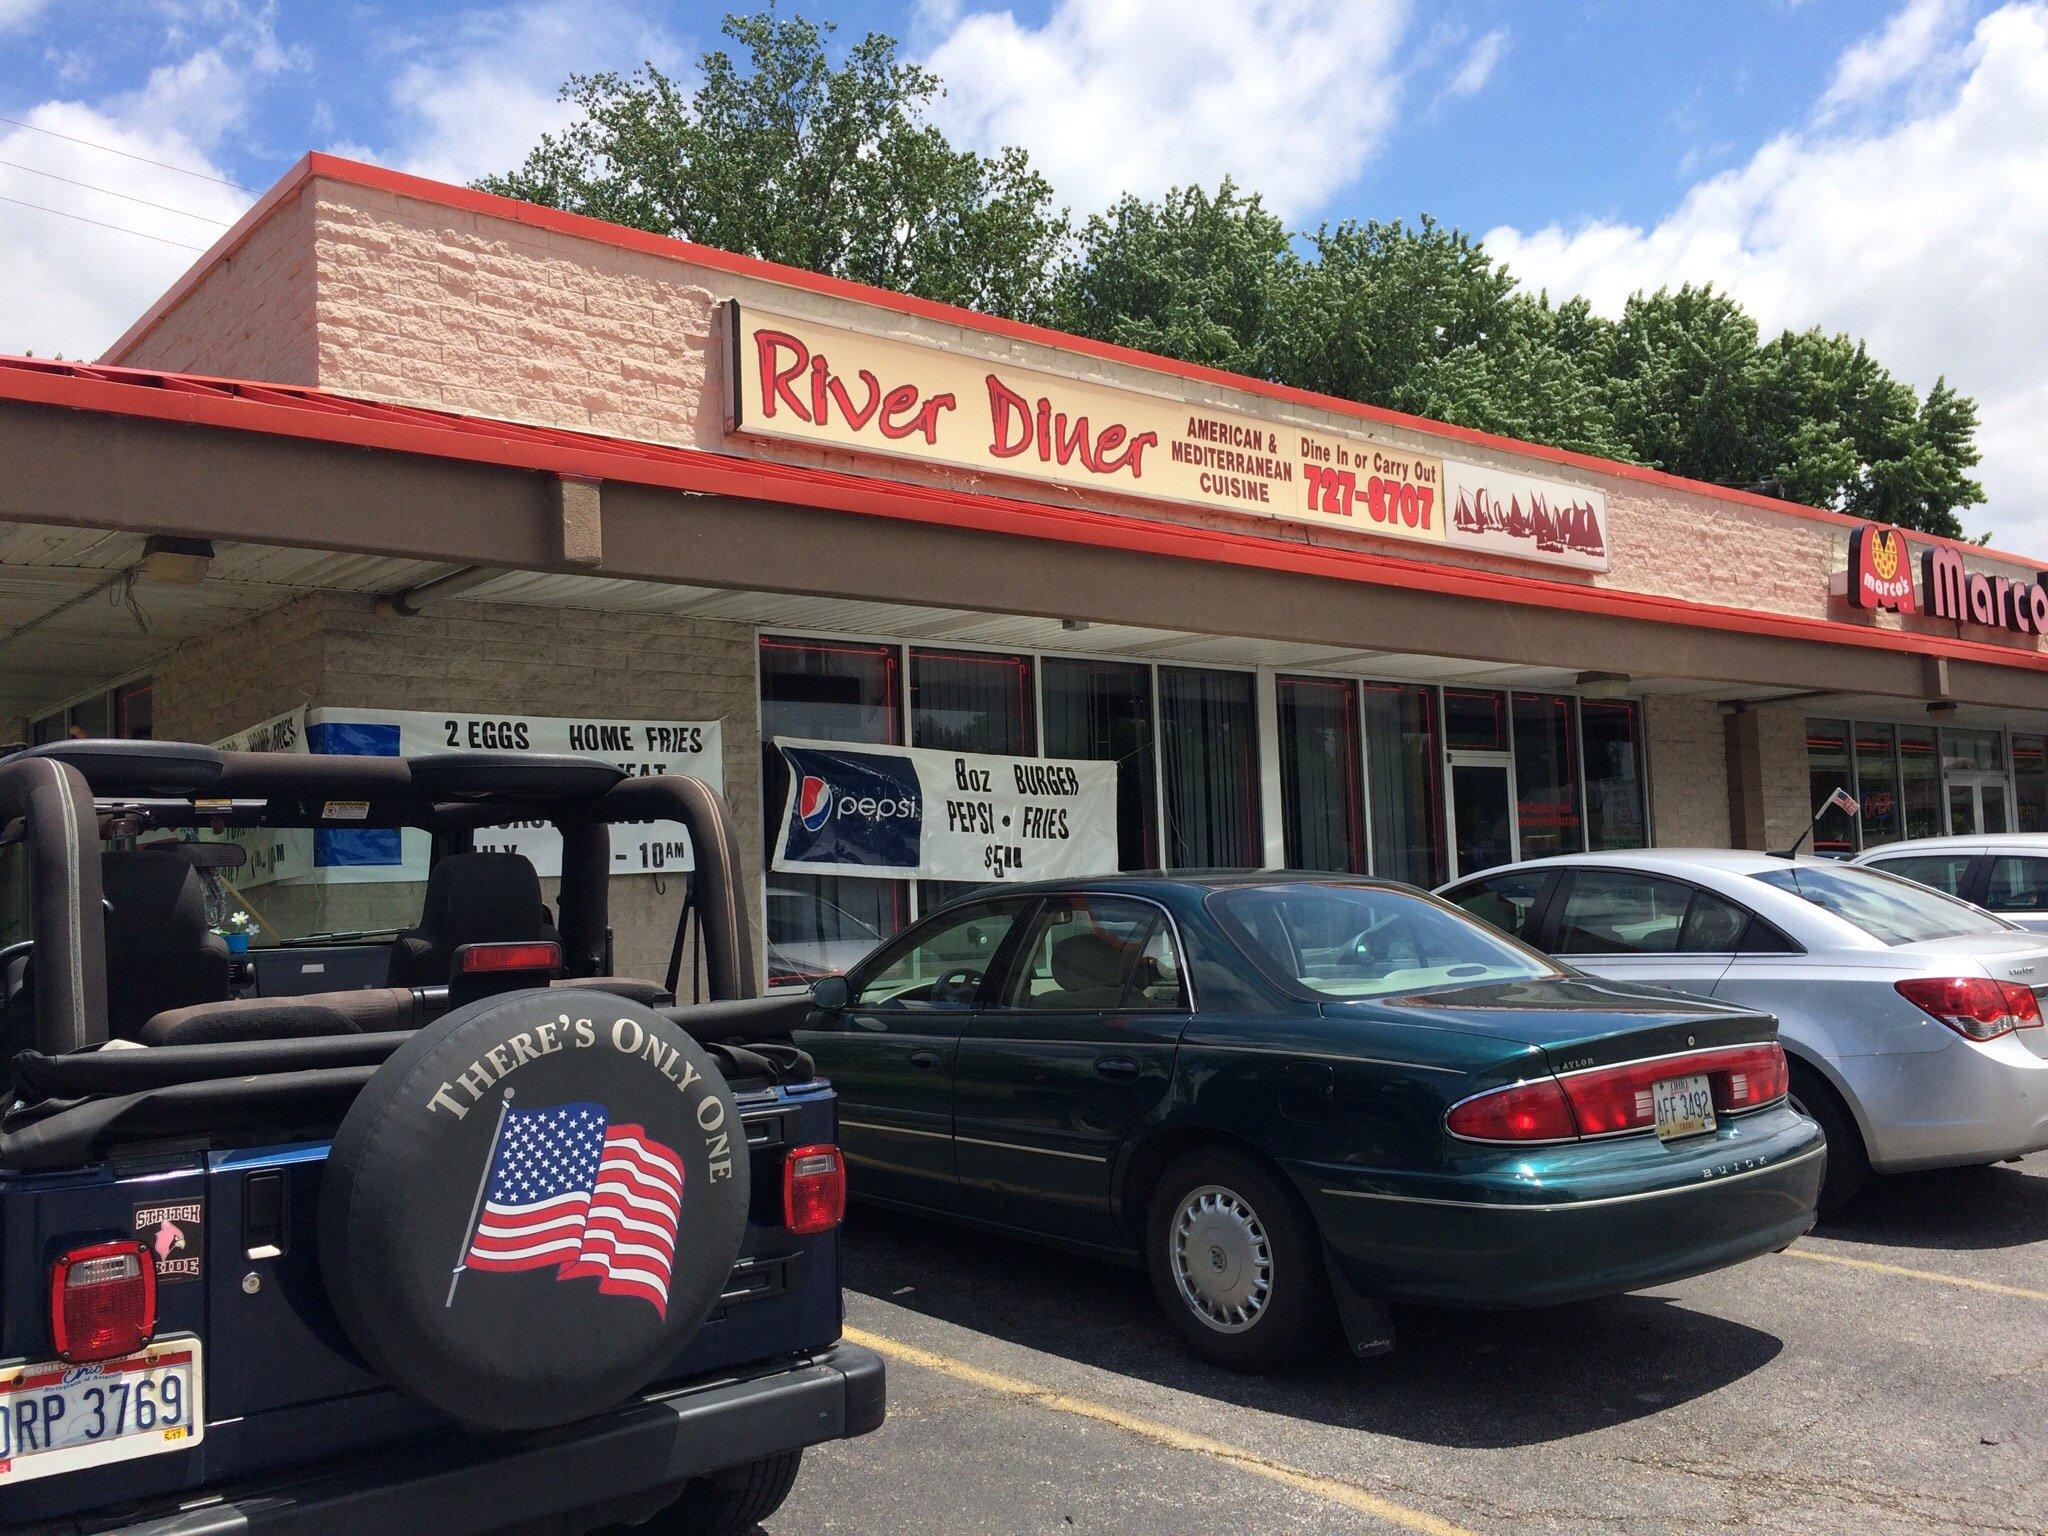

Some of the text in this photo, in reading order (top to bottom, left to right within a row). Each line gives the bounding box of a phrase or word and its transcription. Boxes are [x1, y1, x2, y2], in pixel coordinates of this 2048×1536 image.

[753, 329, 1158, 478] River Diner
[1187, 416, 1278, 454] AMERICAN &
[1171, 440, 1292, 482] MEDITERRANEAN
[1300, 437, 1436, 484] Dine In or Carry Out
[1200, 472, 1269, 503] CUISINE
[1303, 464, 1434, 530] 727-8707
[445, 719, 704, 754] 2 EGGS HOME FRIES
[1013, 763, 1080, 797] BURGER
[837, 796, 918, 821] pepsi
[947, 799, 1070, 840] PEPSI FRIES
[426, 1014, 732, 1185] THERE'S ONLY ONE
[1680, 1090, 1712, 1120] 3492
[1702, 1156, 1768, 1179] BUICK
[136, 1204, 201, 1230] STRITCH
[155, 1257, 199, 1276] RIDE
[83, 1375, 182, 1439] 3769
